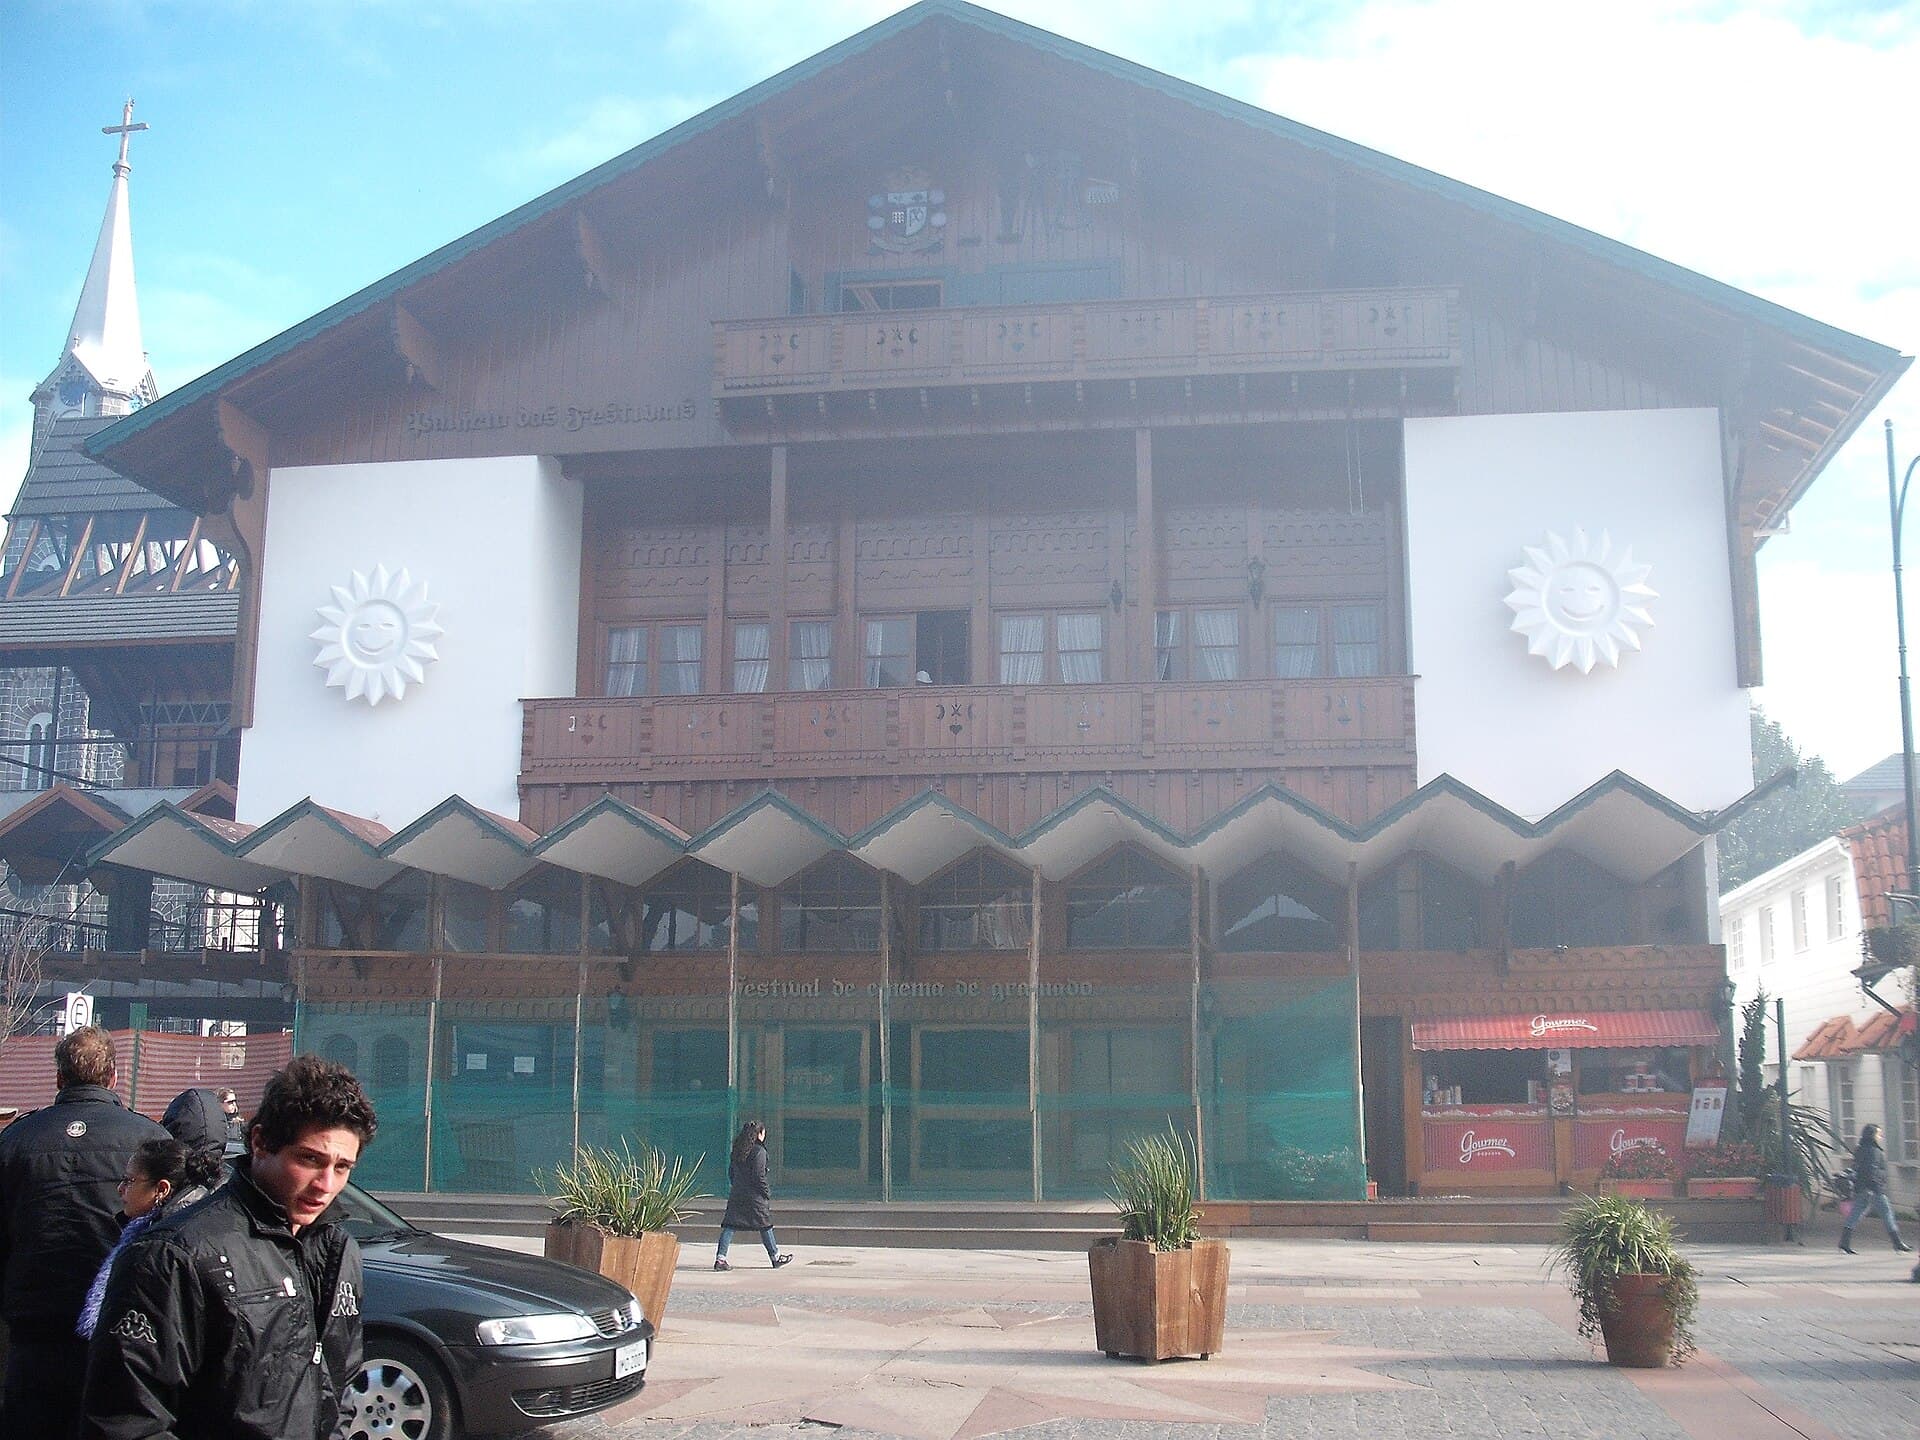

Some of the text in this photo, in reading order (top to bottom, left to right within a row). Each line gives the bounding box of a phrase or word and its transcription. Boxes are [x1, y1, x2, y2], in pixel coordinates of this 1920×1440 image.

[516, 406, 558, 428] dos
[832, 977, 857, 998] de
[955, 979, 980, 998] de
[67, 1003, 84, 1026] E
[1530, 1014, 1598, 1037] Gourmet
[1459, 1129, 1516, 1164] Gourmet
